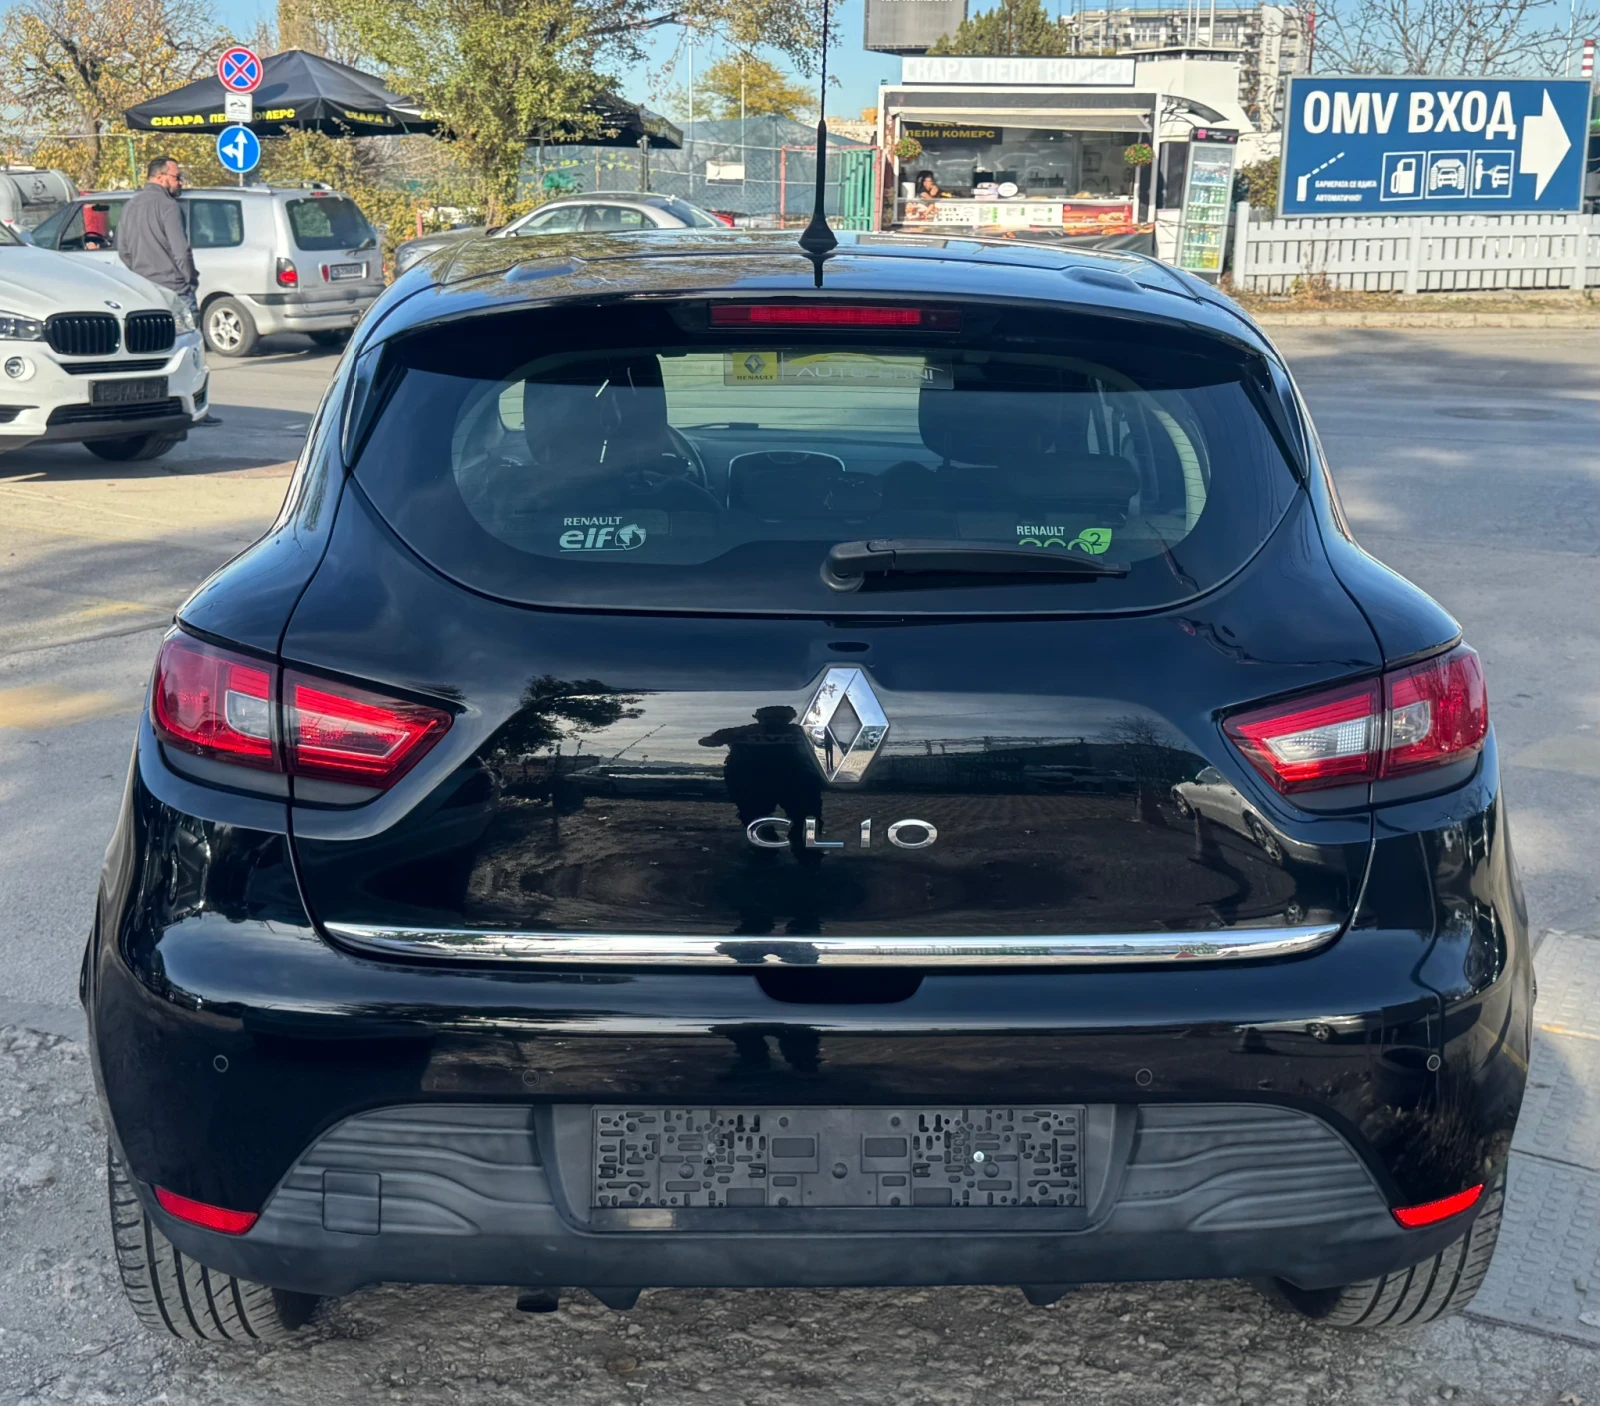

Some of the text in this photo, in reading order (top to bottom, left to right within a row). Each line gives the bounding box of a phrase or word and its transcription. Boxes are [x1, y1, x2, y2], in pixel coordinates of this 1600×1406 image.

[906, 59, 973, 82] СКАРА
[983, 60, 1036, 82] ПЕПИ
[151, 114, 204, 126] СКАРА
[253, 109, 296, 121] ОМЕРС
[1303, 90, 1399, 134] OMV
[1407, 91, 1517, 140] ВХОД
[905, 129, 996, 138] ПЕПИ КОМЕРС
[797, 367, 868, 378] AUTO
[563, 516, 623, 526] RENAULT
[559, 527, 615, 548] elf
[1016, 525, 1065, 536] RENAULT
[746, 816, 938, 849] CLIO
